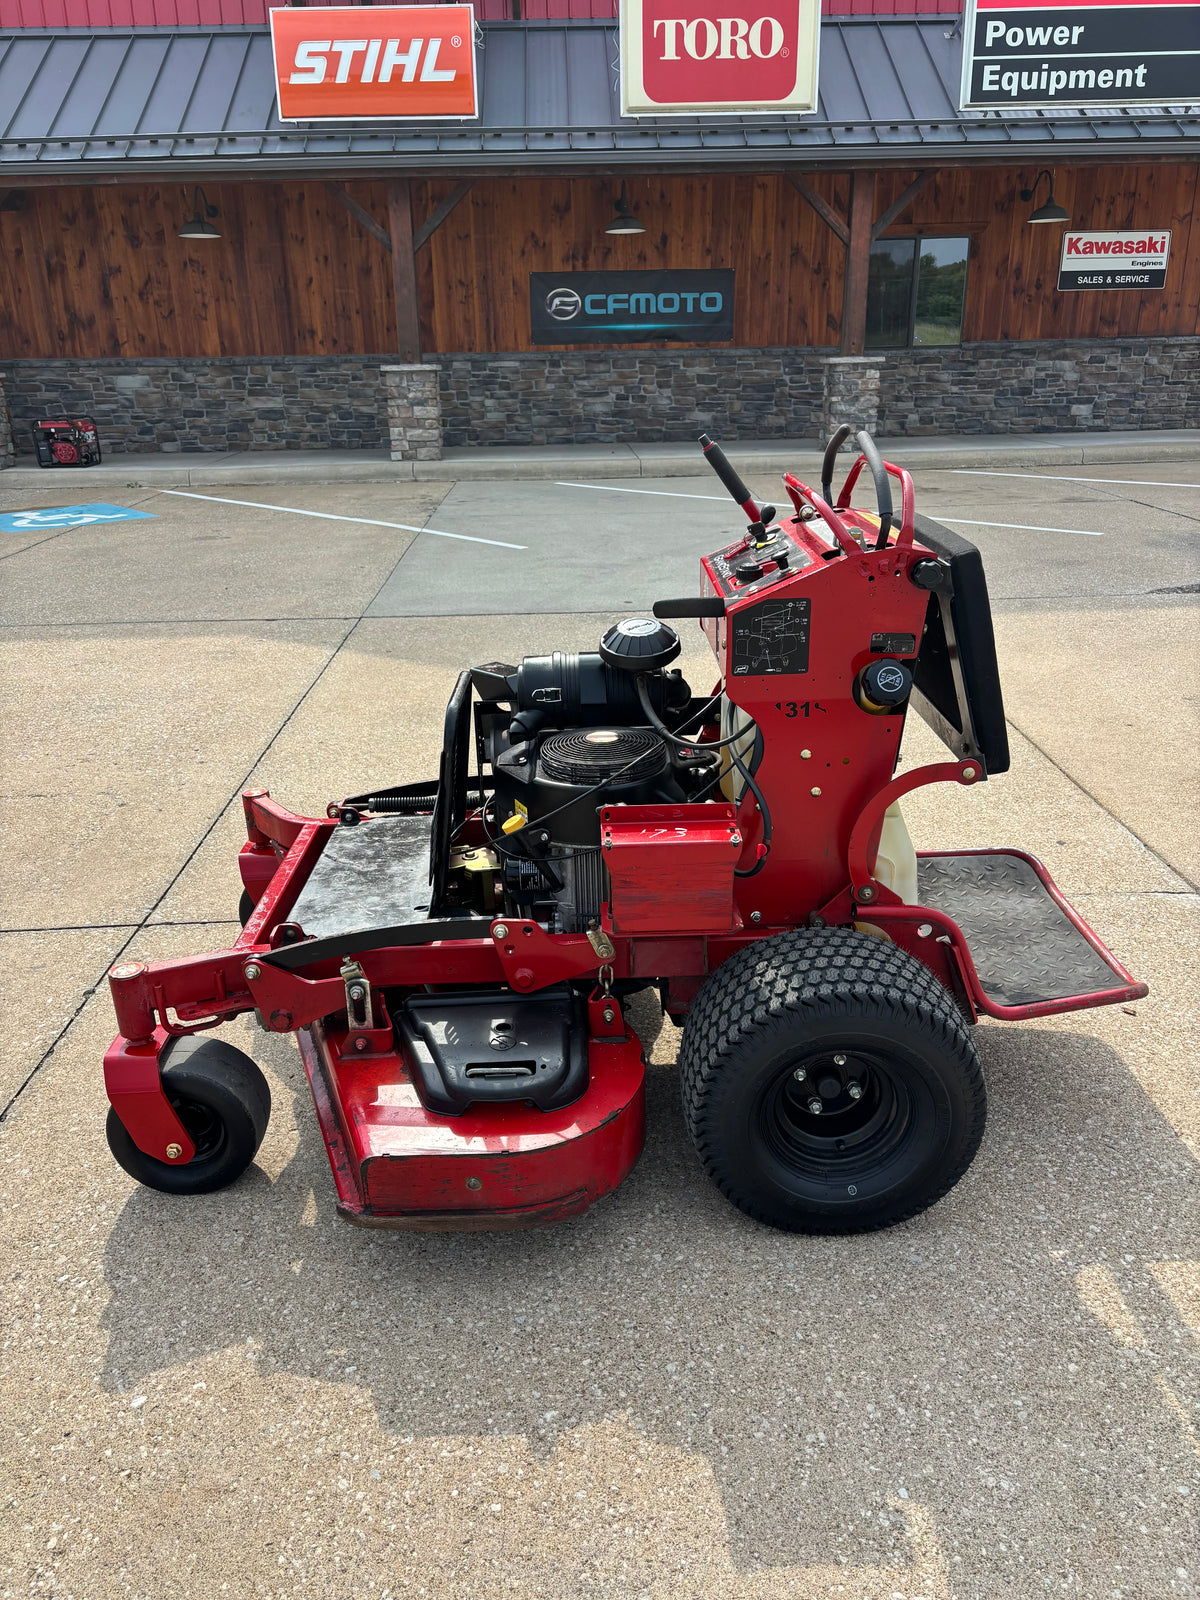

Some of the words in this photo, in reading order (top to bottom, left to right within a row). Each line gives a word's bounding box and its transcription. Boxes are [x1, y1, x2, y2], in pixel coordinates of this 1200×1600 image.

[653, 16, 785, 62] TORO
[985, 20, 1085, 48] Power
[289, 38, 457, 85] STIHL
[982, 63, 1148, 97] Equipment
[1066, 236, 1167, 255] Kawasaki
[1131, 260, 1164, 268] Engines
[1077, 276, 1104, 285] SALES
[1106, 276, 1112, 284] &
[1115, 275, 1150, 283] SERVICE
[584, 291, 723, 315] CFMOTO
